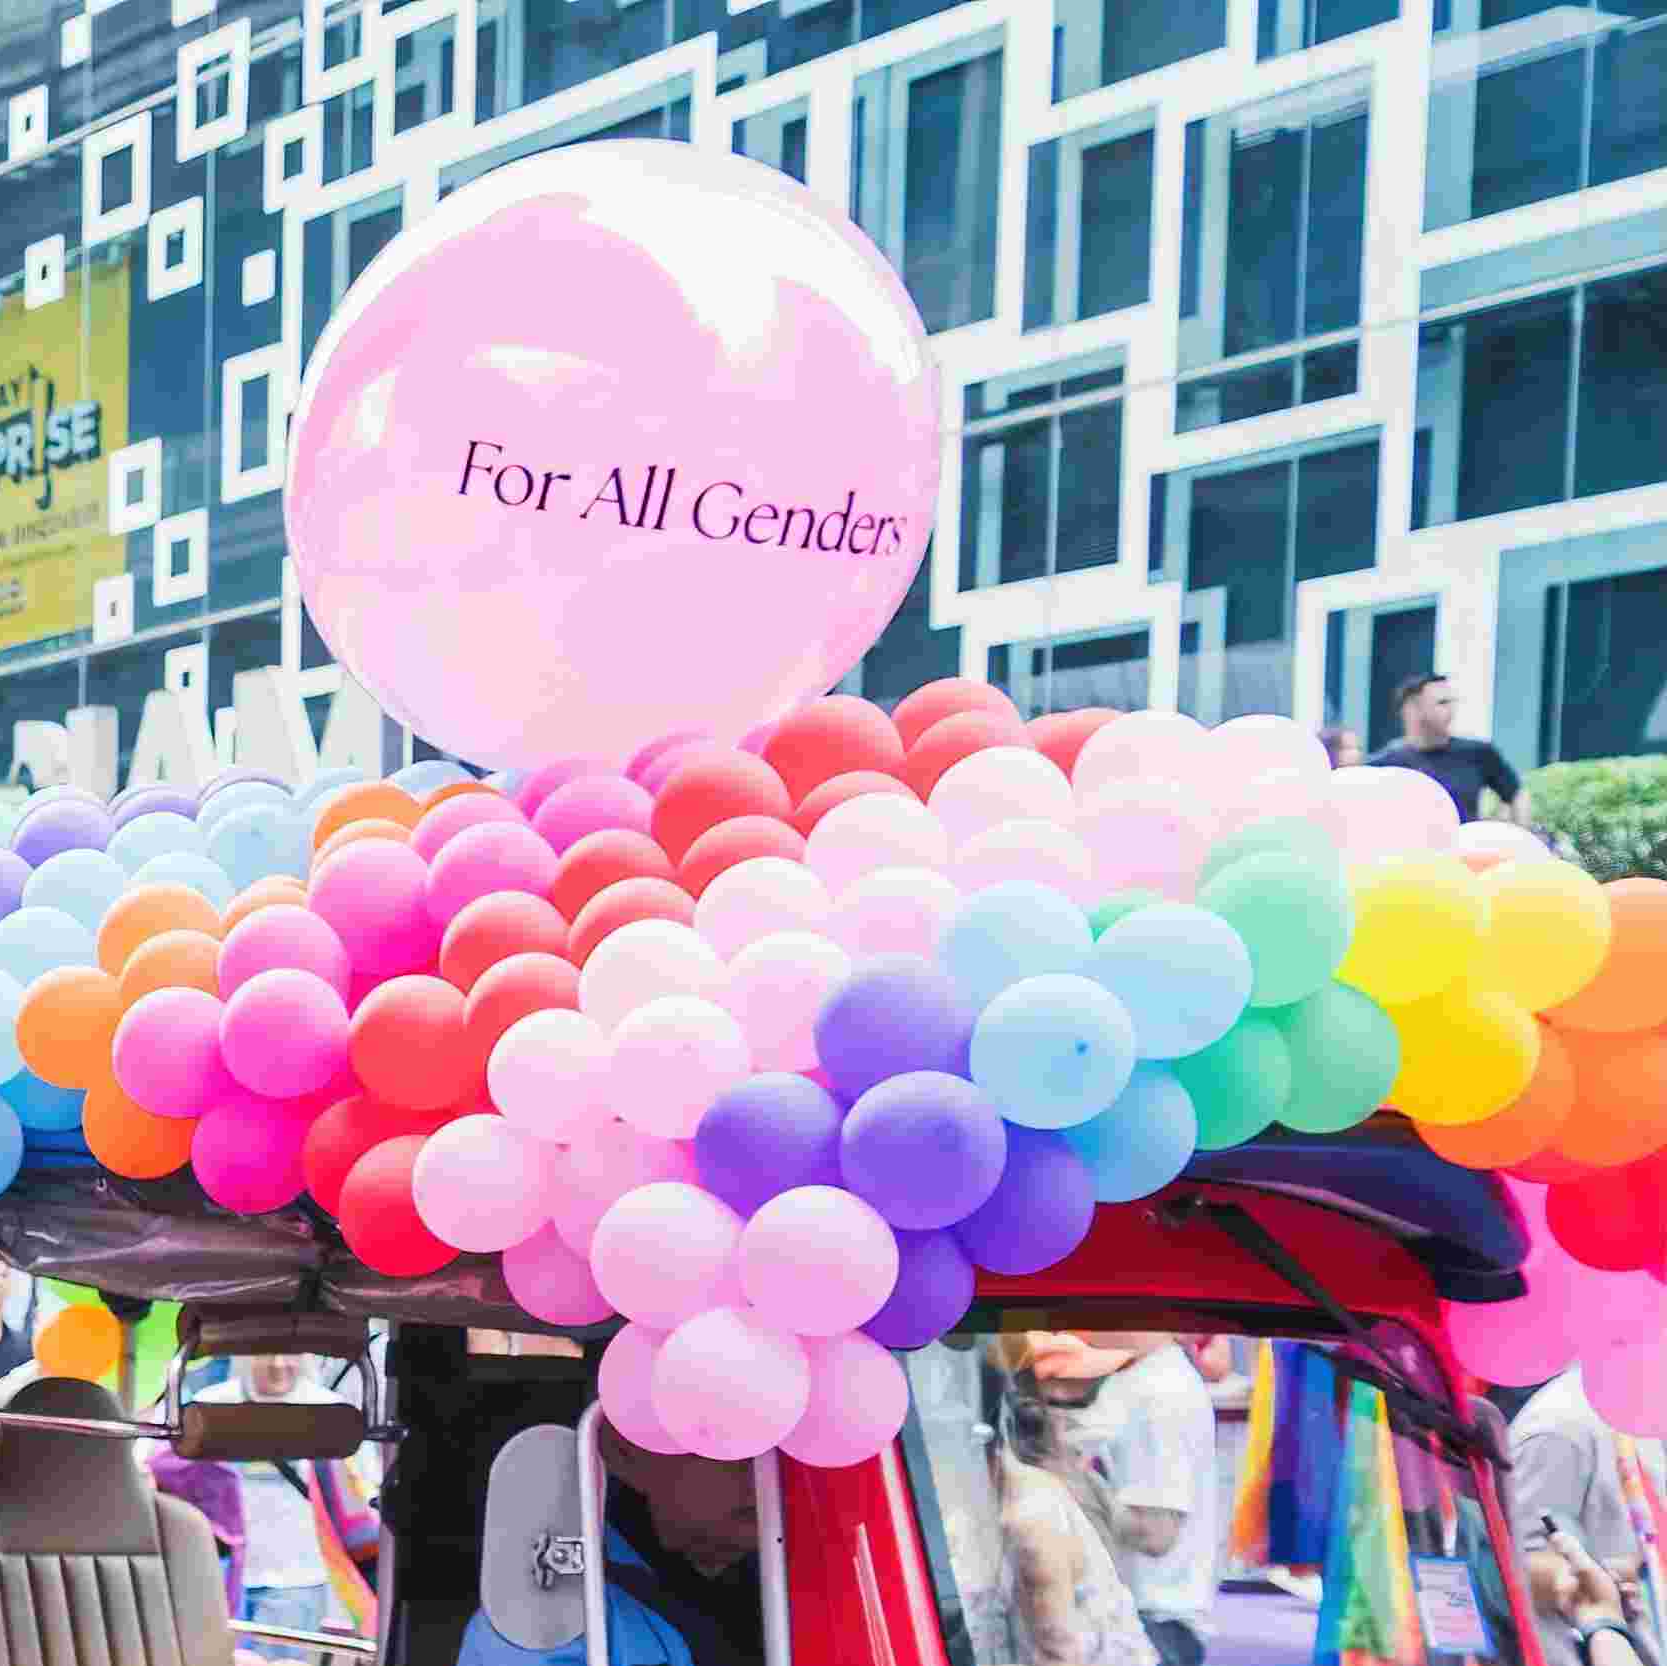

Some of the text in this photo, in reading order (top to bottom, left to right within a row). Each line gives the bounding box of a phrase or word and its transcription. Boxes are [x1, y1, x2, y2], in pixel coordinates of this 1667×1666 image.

[458, 440, 903, 556] For All Genders
